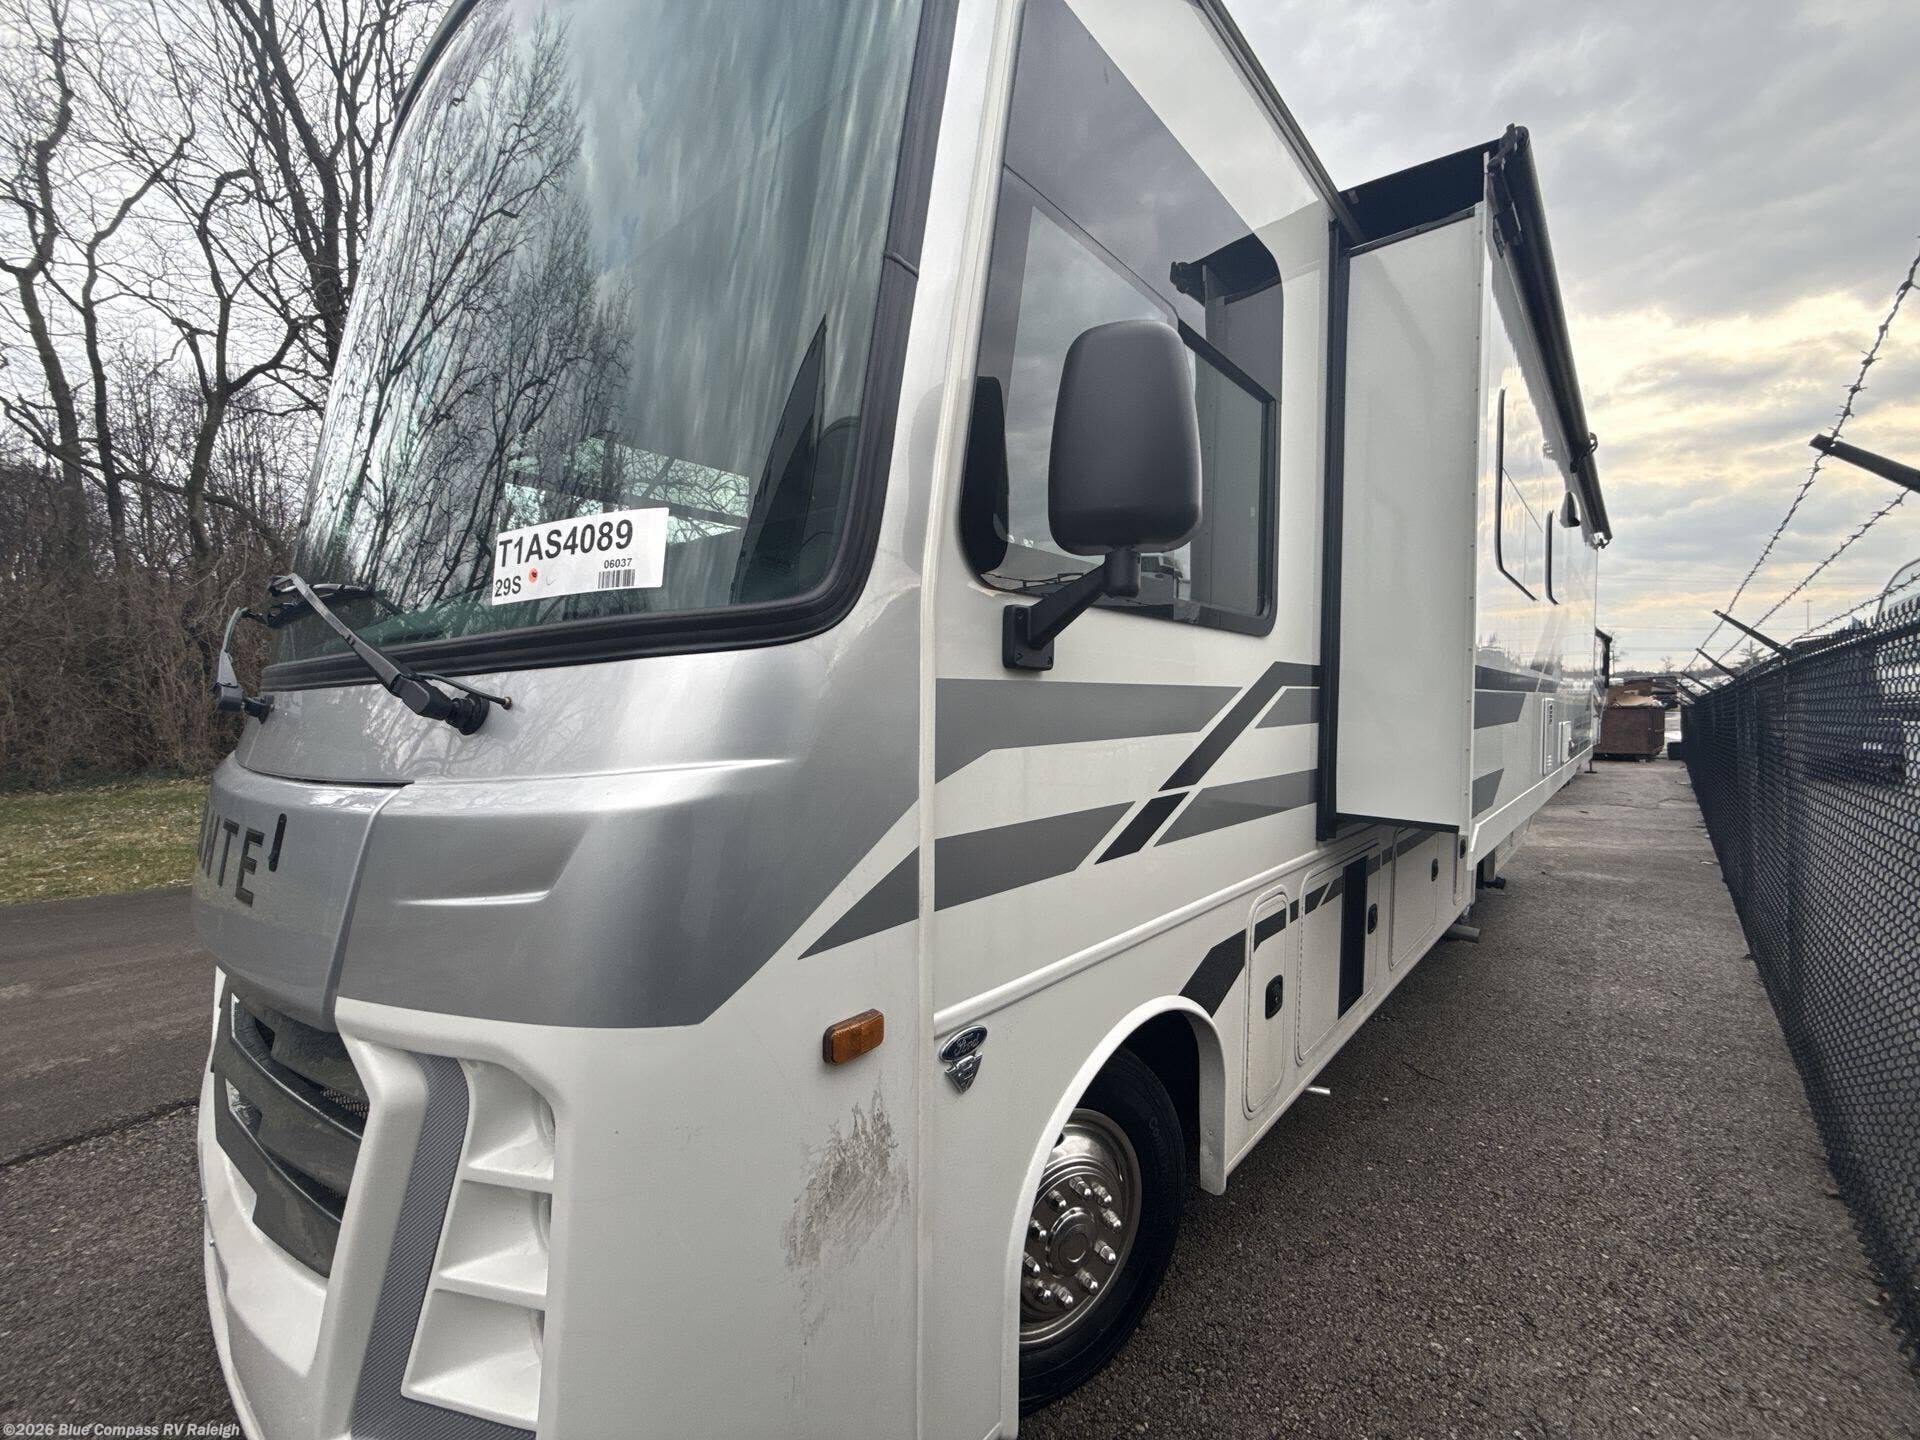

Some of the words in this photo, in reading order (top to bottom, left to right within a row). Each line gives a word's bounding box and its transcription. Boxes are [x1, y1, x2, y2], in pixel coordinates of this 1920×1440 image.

[499, 519, 633, 567] T1AS4089
[603, 557, 633, 569] 06037
[494, 575, 522, 598] 29S
